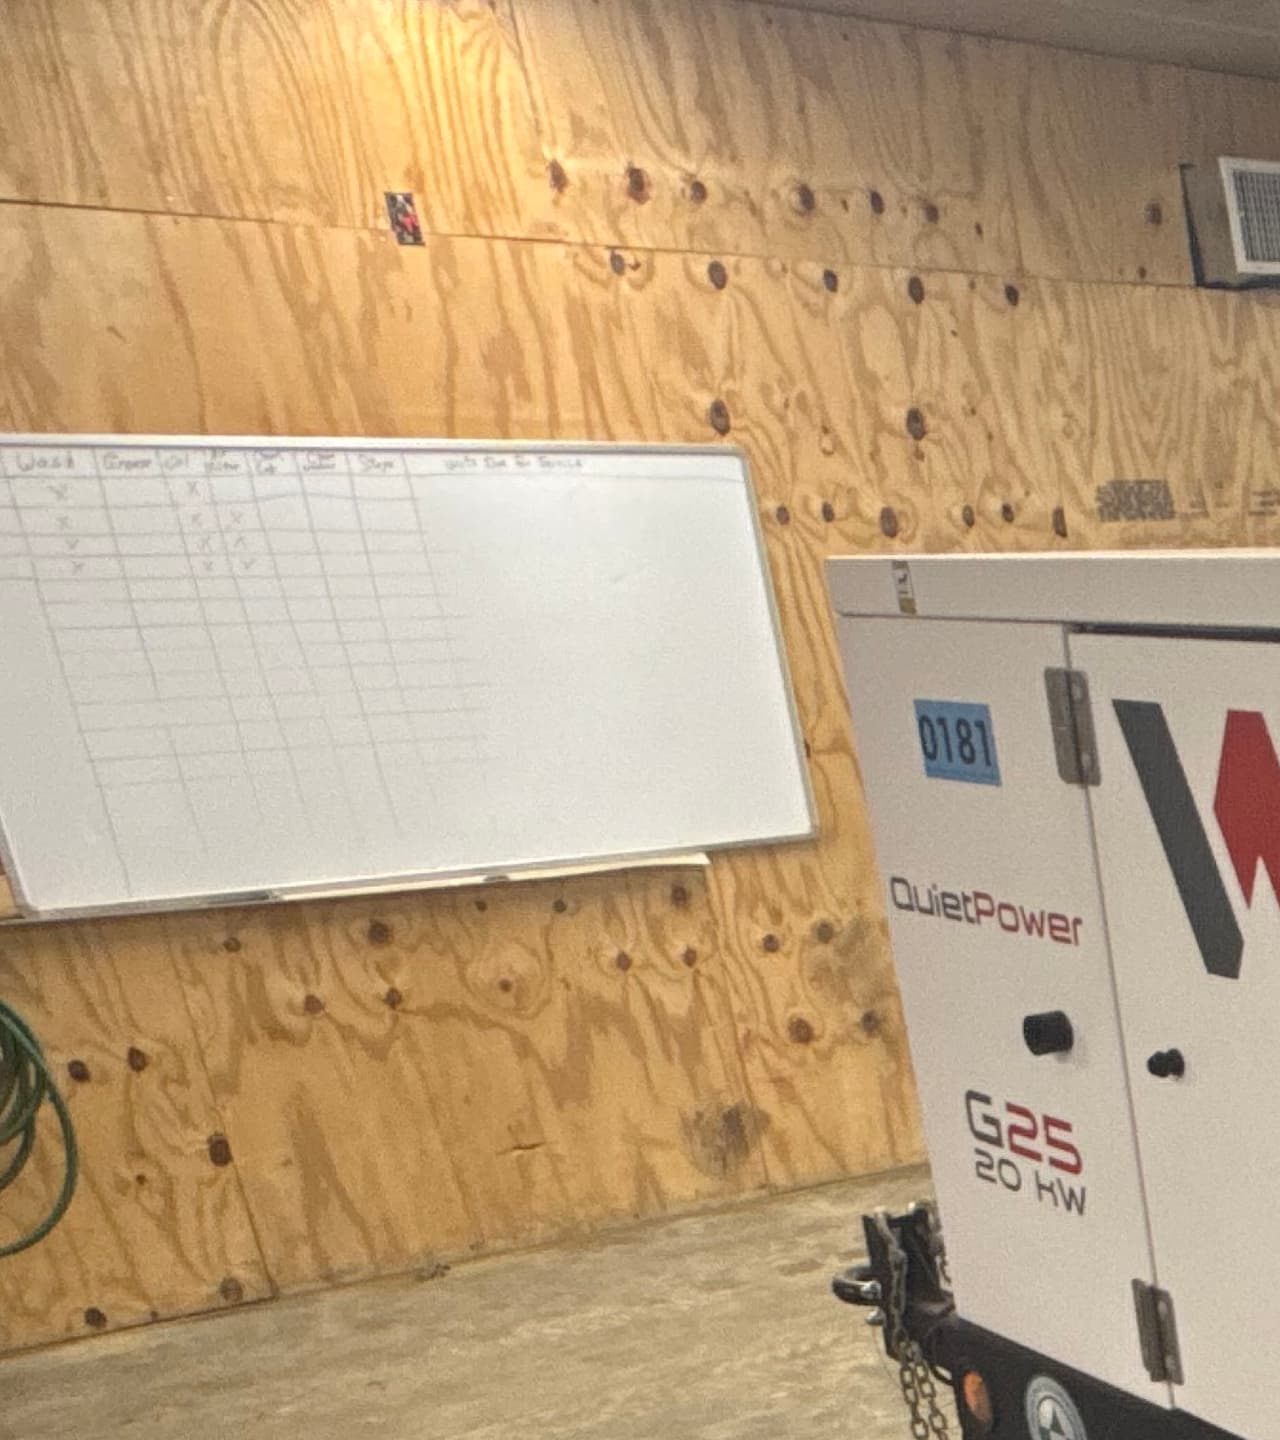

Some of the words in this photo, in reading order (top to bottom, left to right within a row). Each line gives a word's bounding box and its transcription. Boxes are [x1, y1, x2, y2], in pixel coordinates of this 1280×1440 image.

[918, 714, 993, 767] 0181
[889, 876, 1083, 947] QuietPower
[964, 1089, 1083, 1176] G25
[974, 1146, 1022, 1192] 20
